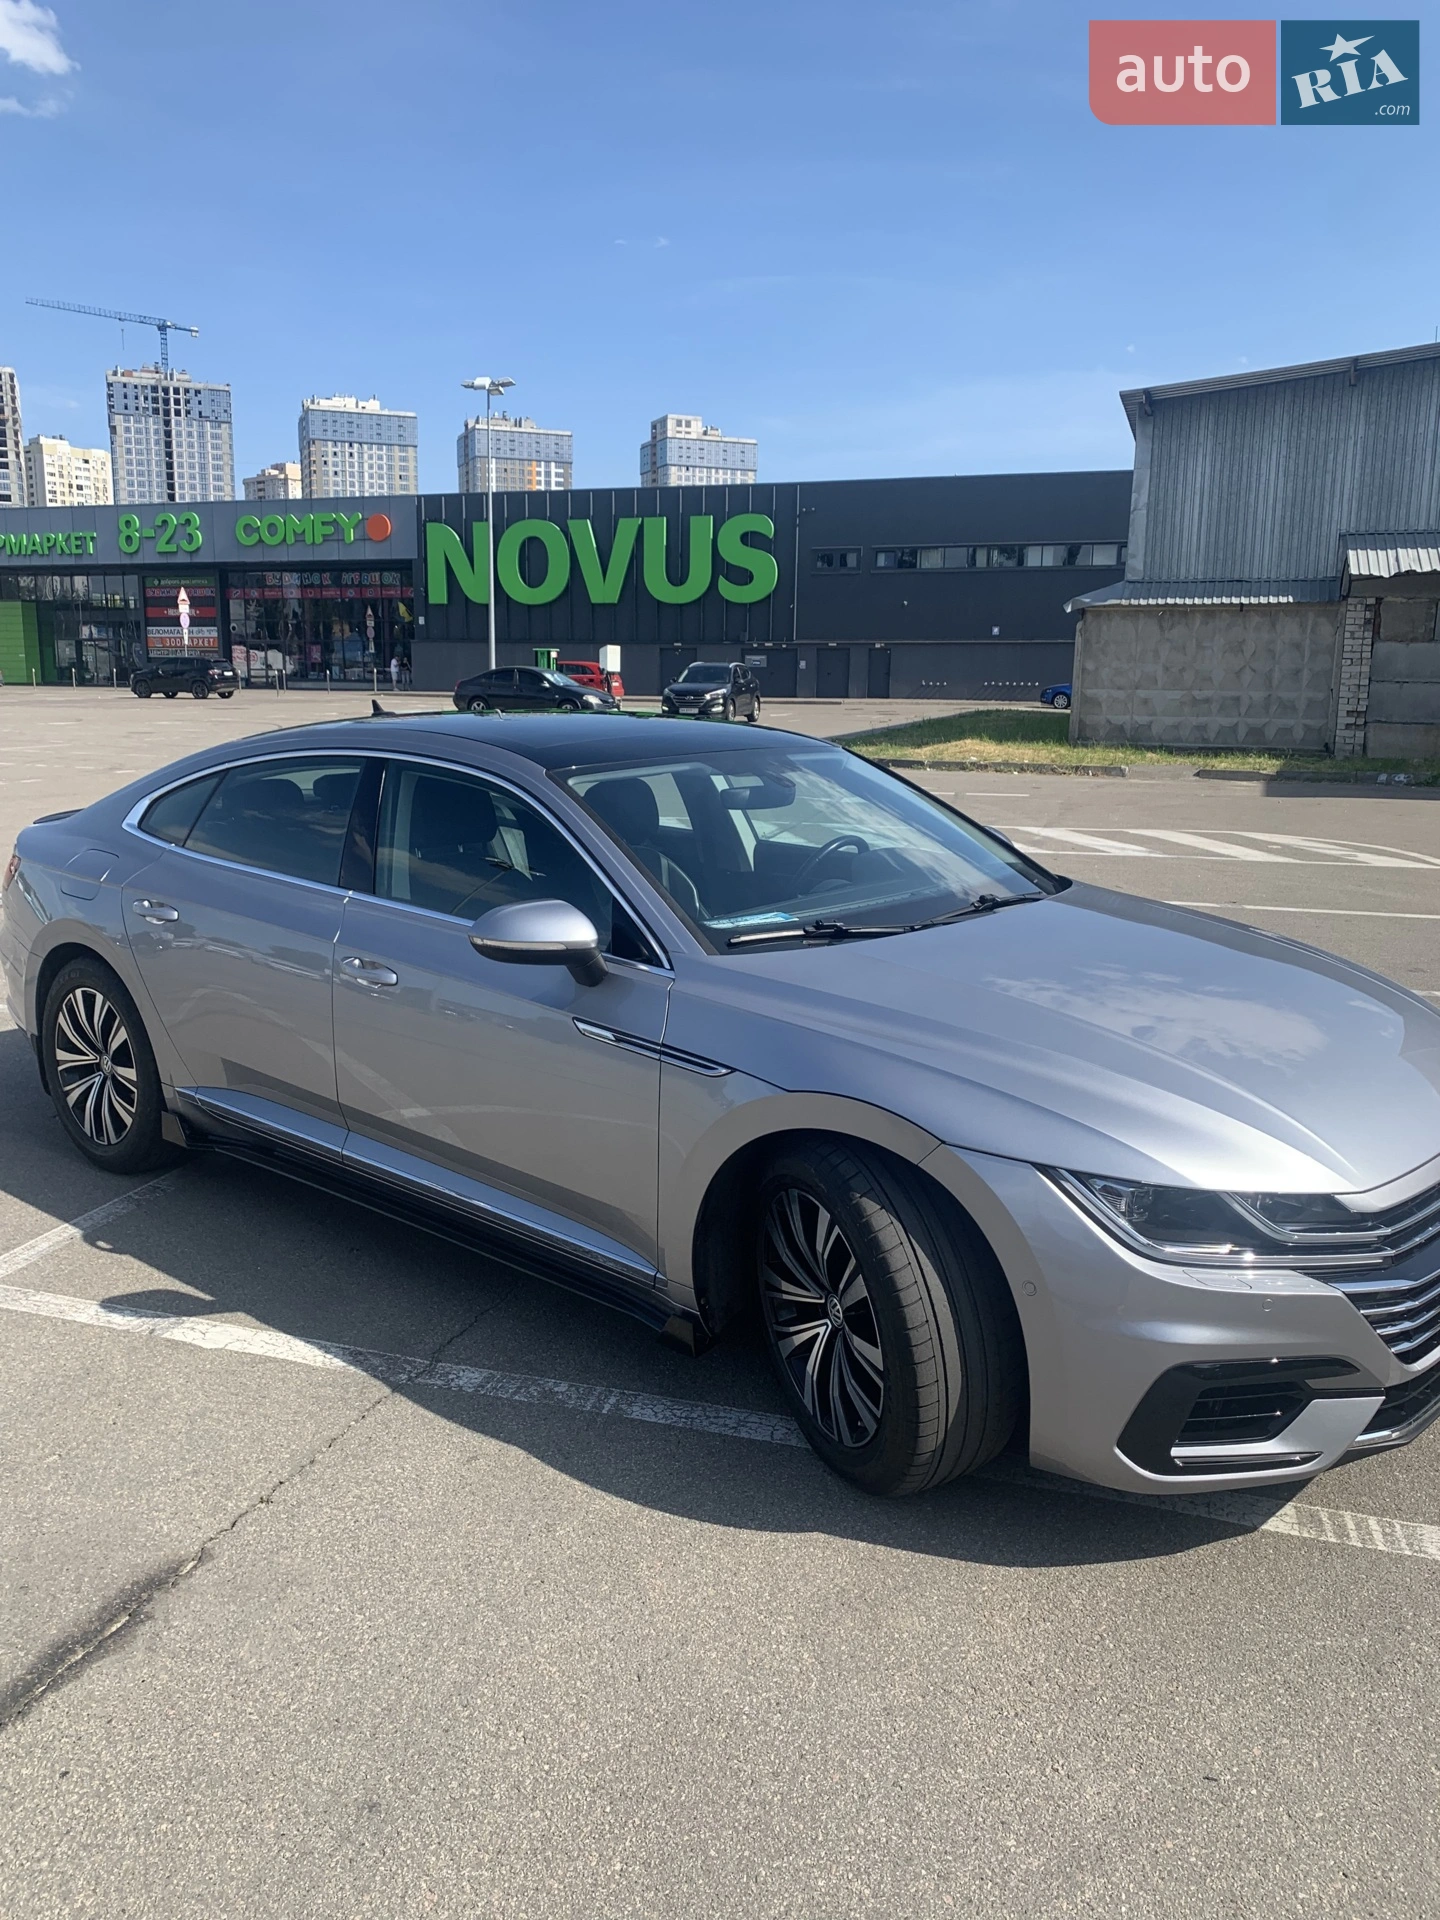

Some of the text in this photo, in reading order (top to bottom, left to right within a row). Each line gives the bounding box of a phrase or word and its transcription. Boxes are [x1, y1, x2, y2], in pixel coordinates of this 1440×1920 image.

[118, 511, 203, 554] 8-23
[235, 512, 362, 546] COMFY
[426, 513, 779, 605] NOVUS
[265, 572, 332, 586] БУДИНОК
[147, 628, 194, 636] ВЕЛОМАГАЗН
